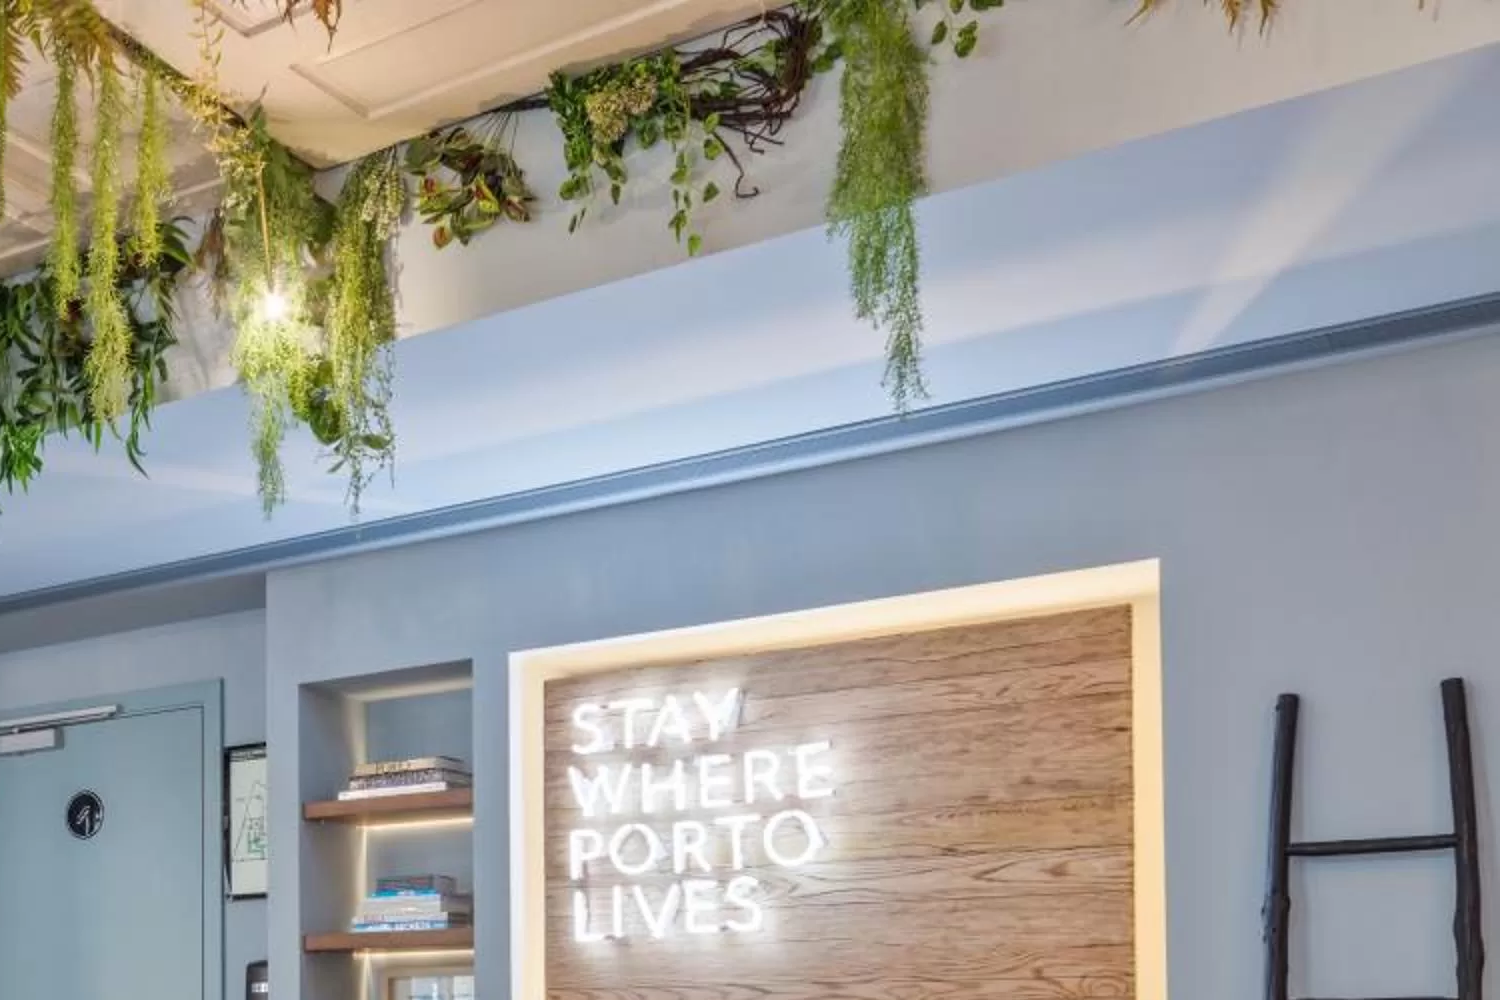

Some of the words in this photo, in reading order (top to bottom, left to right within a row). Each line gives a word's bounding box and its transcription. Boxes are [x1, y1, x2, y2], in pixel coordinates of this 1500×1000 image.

[571, 687, 741, 755] STAY
[567, 740, 835, 817] WHERE
[569, 809, 820, 880] PORTO
[573, 876, 764, 942] LIVES
